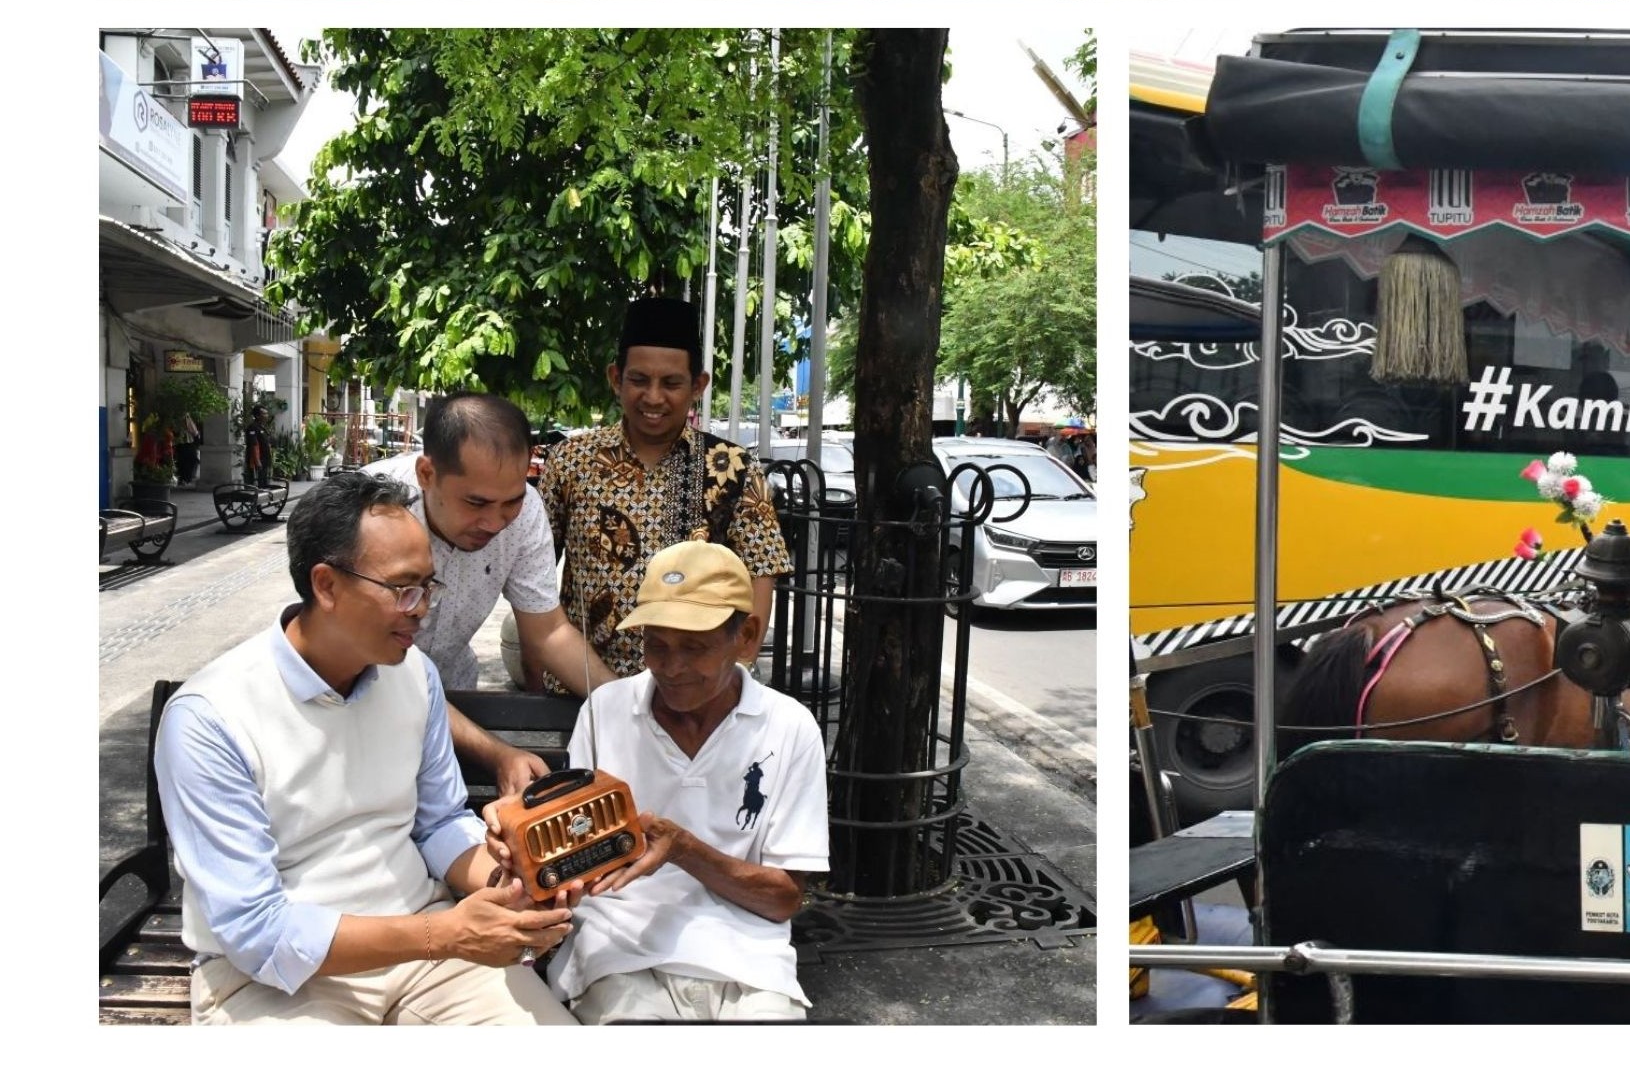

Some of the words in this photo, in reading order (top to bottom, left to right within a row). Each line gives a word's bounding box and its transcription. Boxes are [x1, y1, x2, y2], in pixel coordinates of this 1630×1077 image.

[1362, 204, 1387, 216] Batik
[1556, 204, 1582, 216] Batik
[1430, 212, 1472, 223] TUPITU
